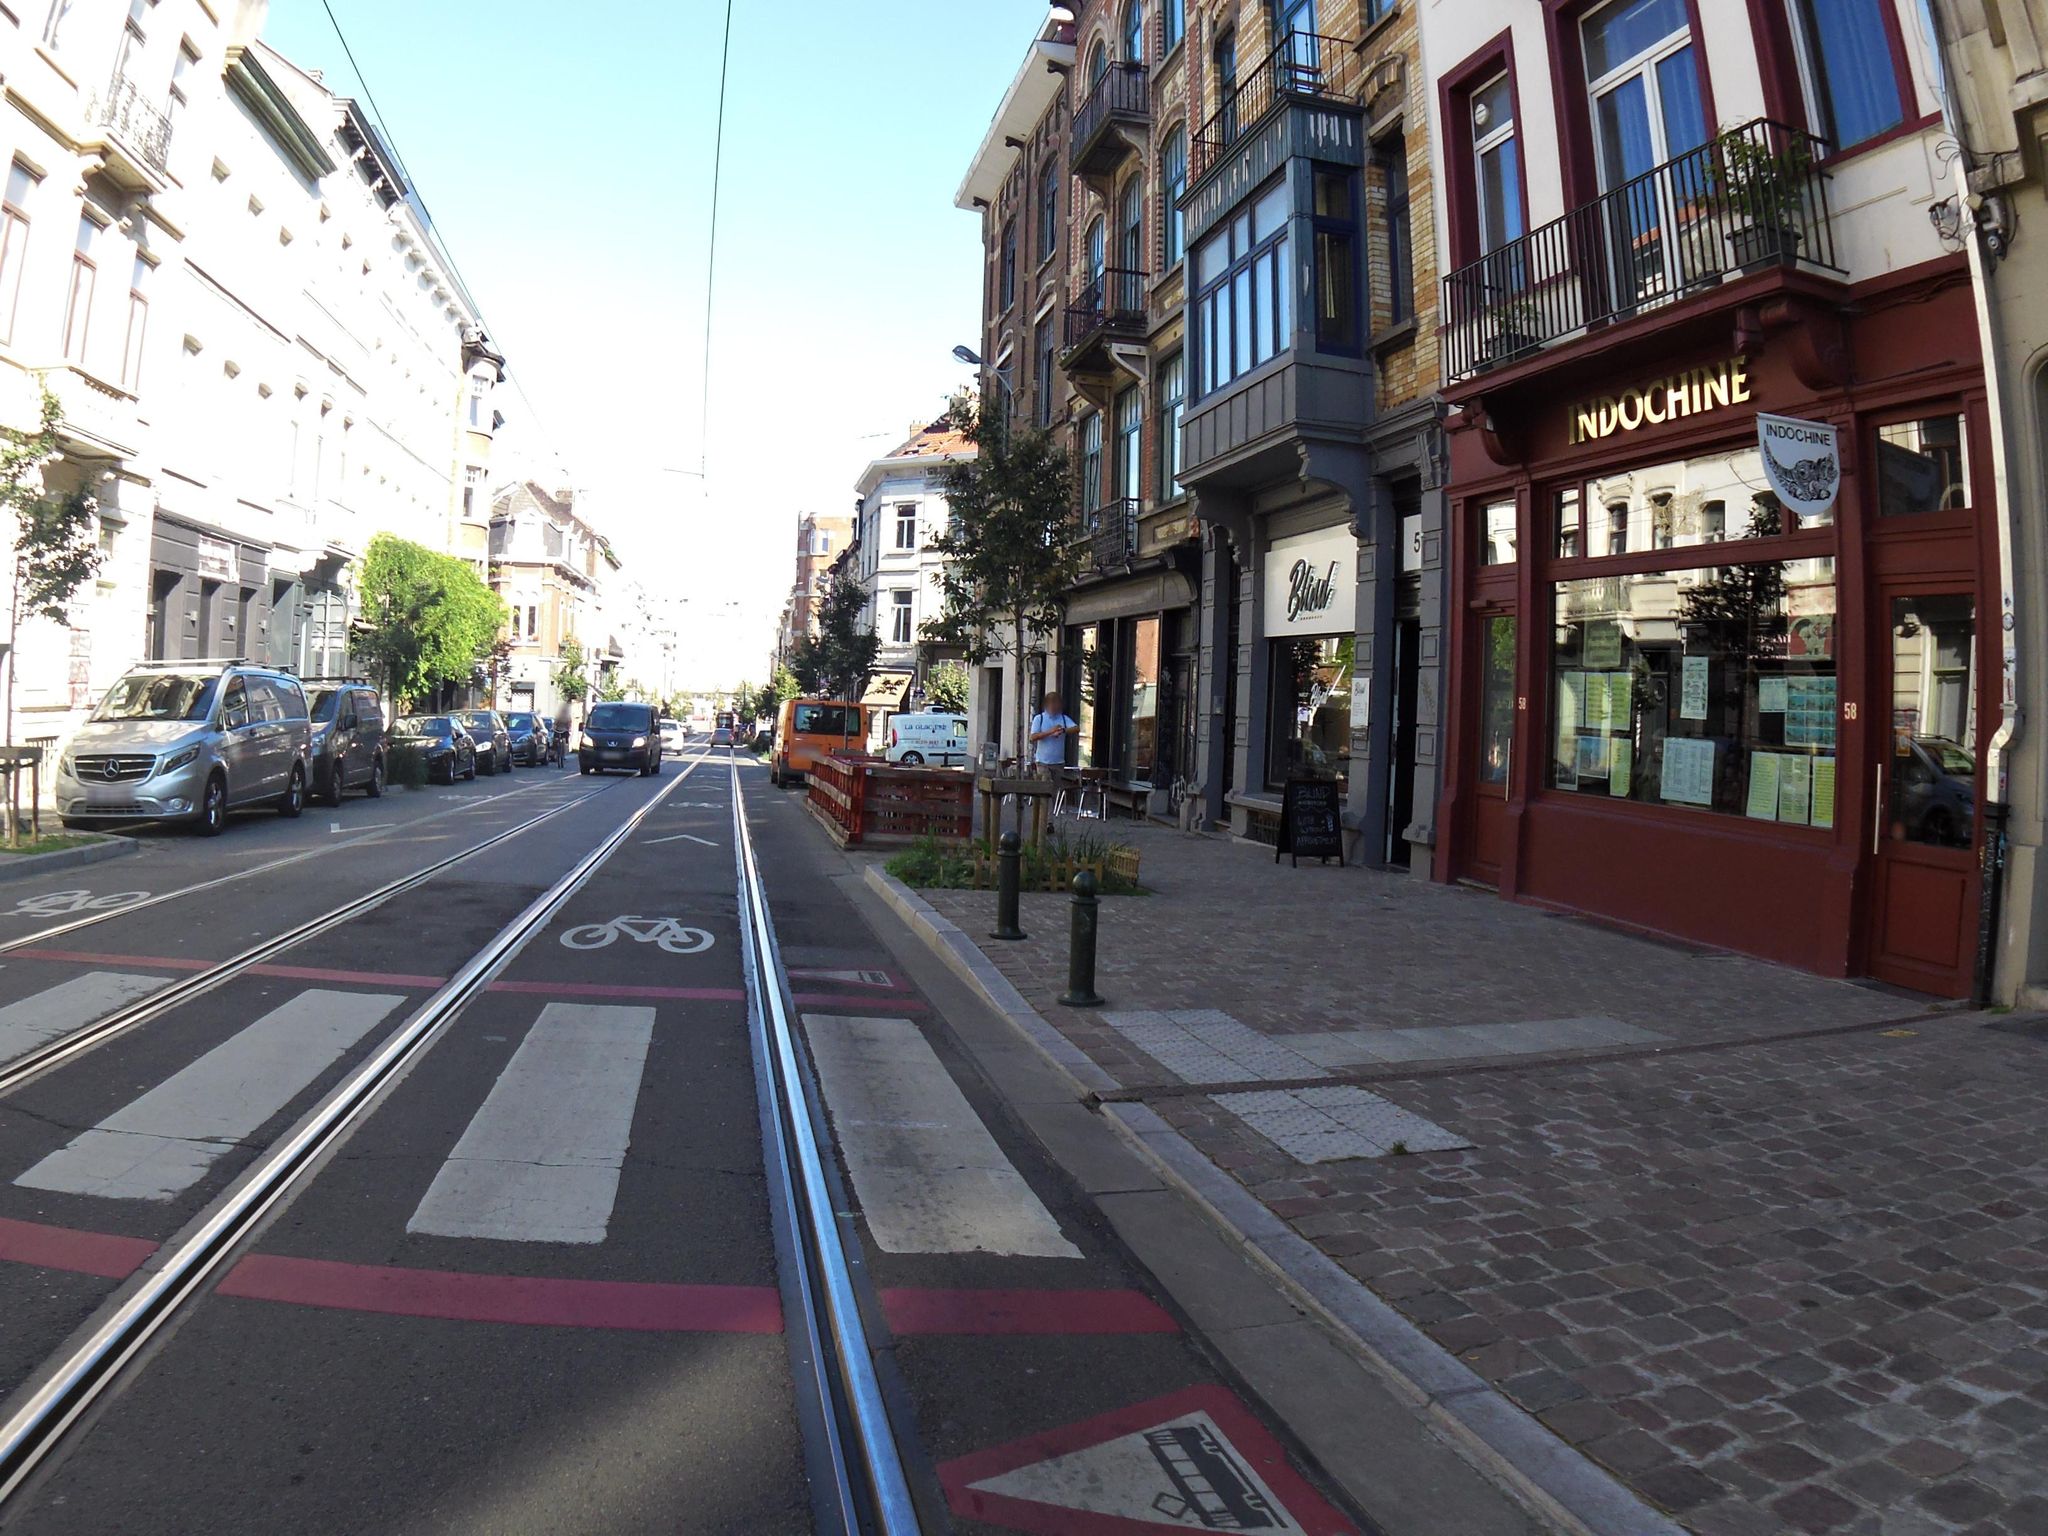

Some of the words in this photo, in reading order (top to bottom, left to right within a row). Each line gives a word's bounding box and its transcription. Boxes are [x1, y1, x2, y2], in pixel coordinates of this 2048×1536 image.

[1568, 354, 1750, 445] INDOCHINE
[1766, 423, 1831, 446] INDOCHINE
[1413, 532, 1421, 553] 5
[1287, 558, 1341, 622] Blind
[1518, 697, 1527, 710] 58
[1844, 702, 1857, 719] 58
